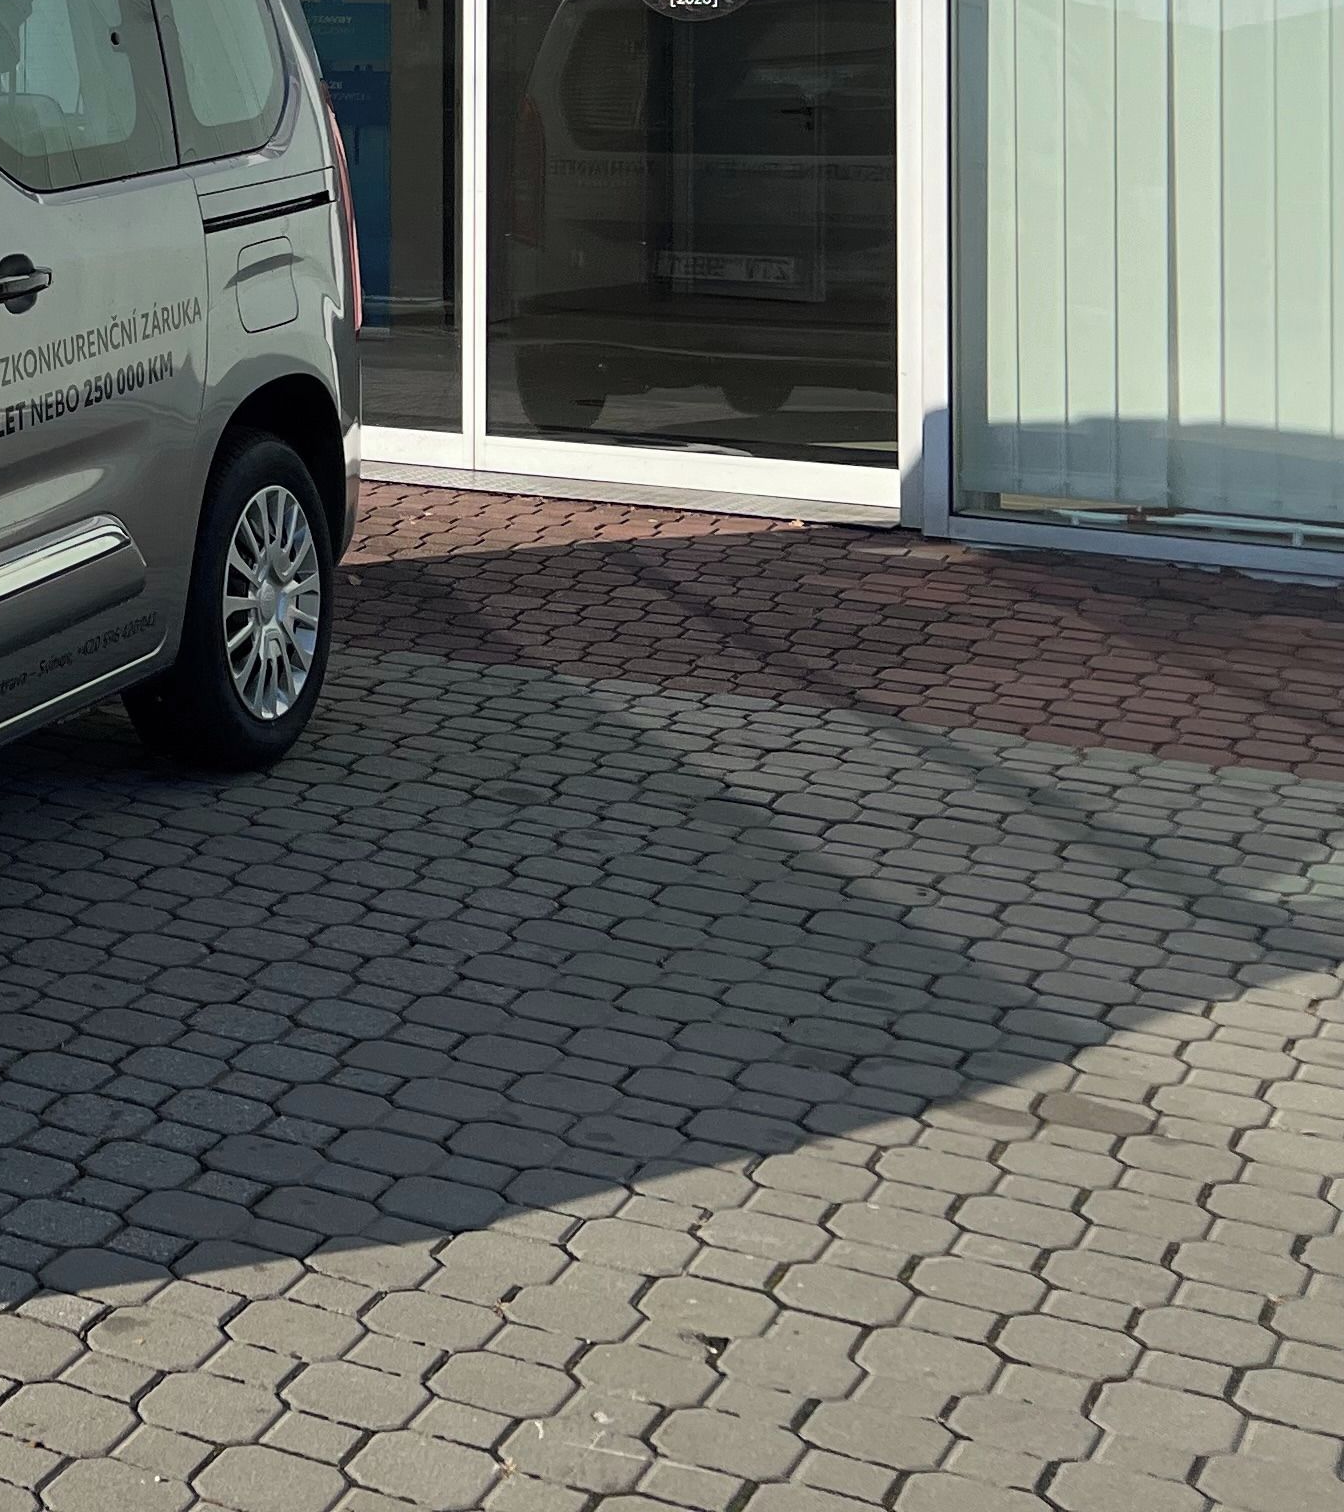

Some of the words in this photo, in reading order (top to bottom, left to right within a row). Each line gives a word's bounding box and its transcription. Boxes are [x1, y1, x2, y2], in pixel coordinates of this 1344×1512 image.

[140, 296, 202, 341] ZÁRUKA
[30, 384, 80, 426] NEBO
[83, 372, 112, 408] 250
[116, 360, 145, 395] 000
[148, 350, 174, 385] KM
